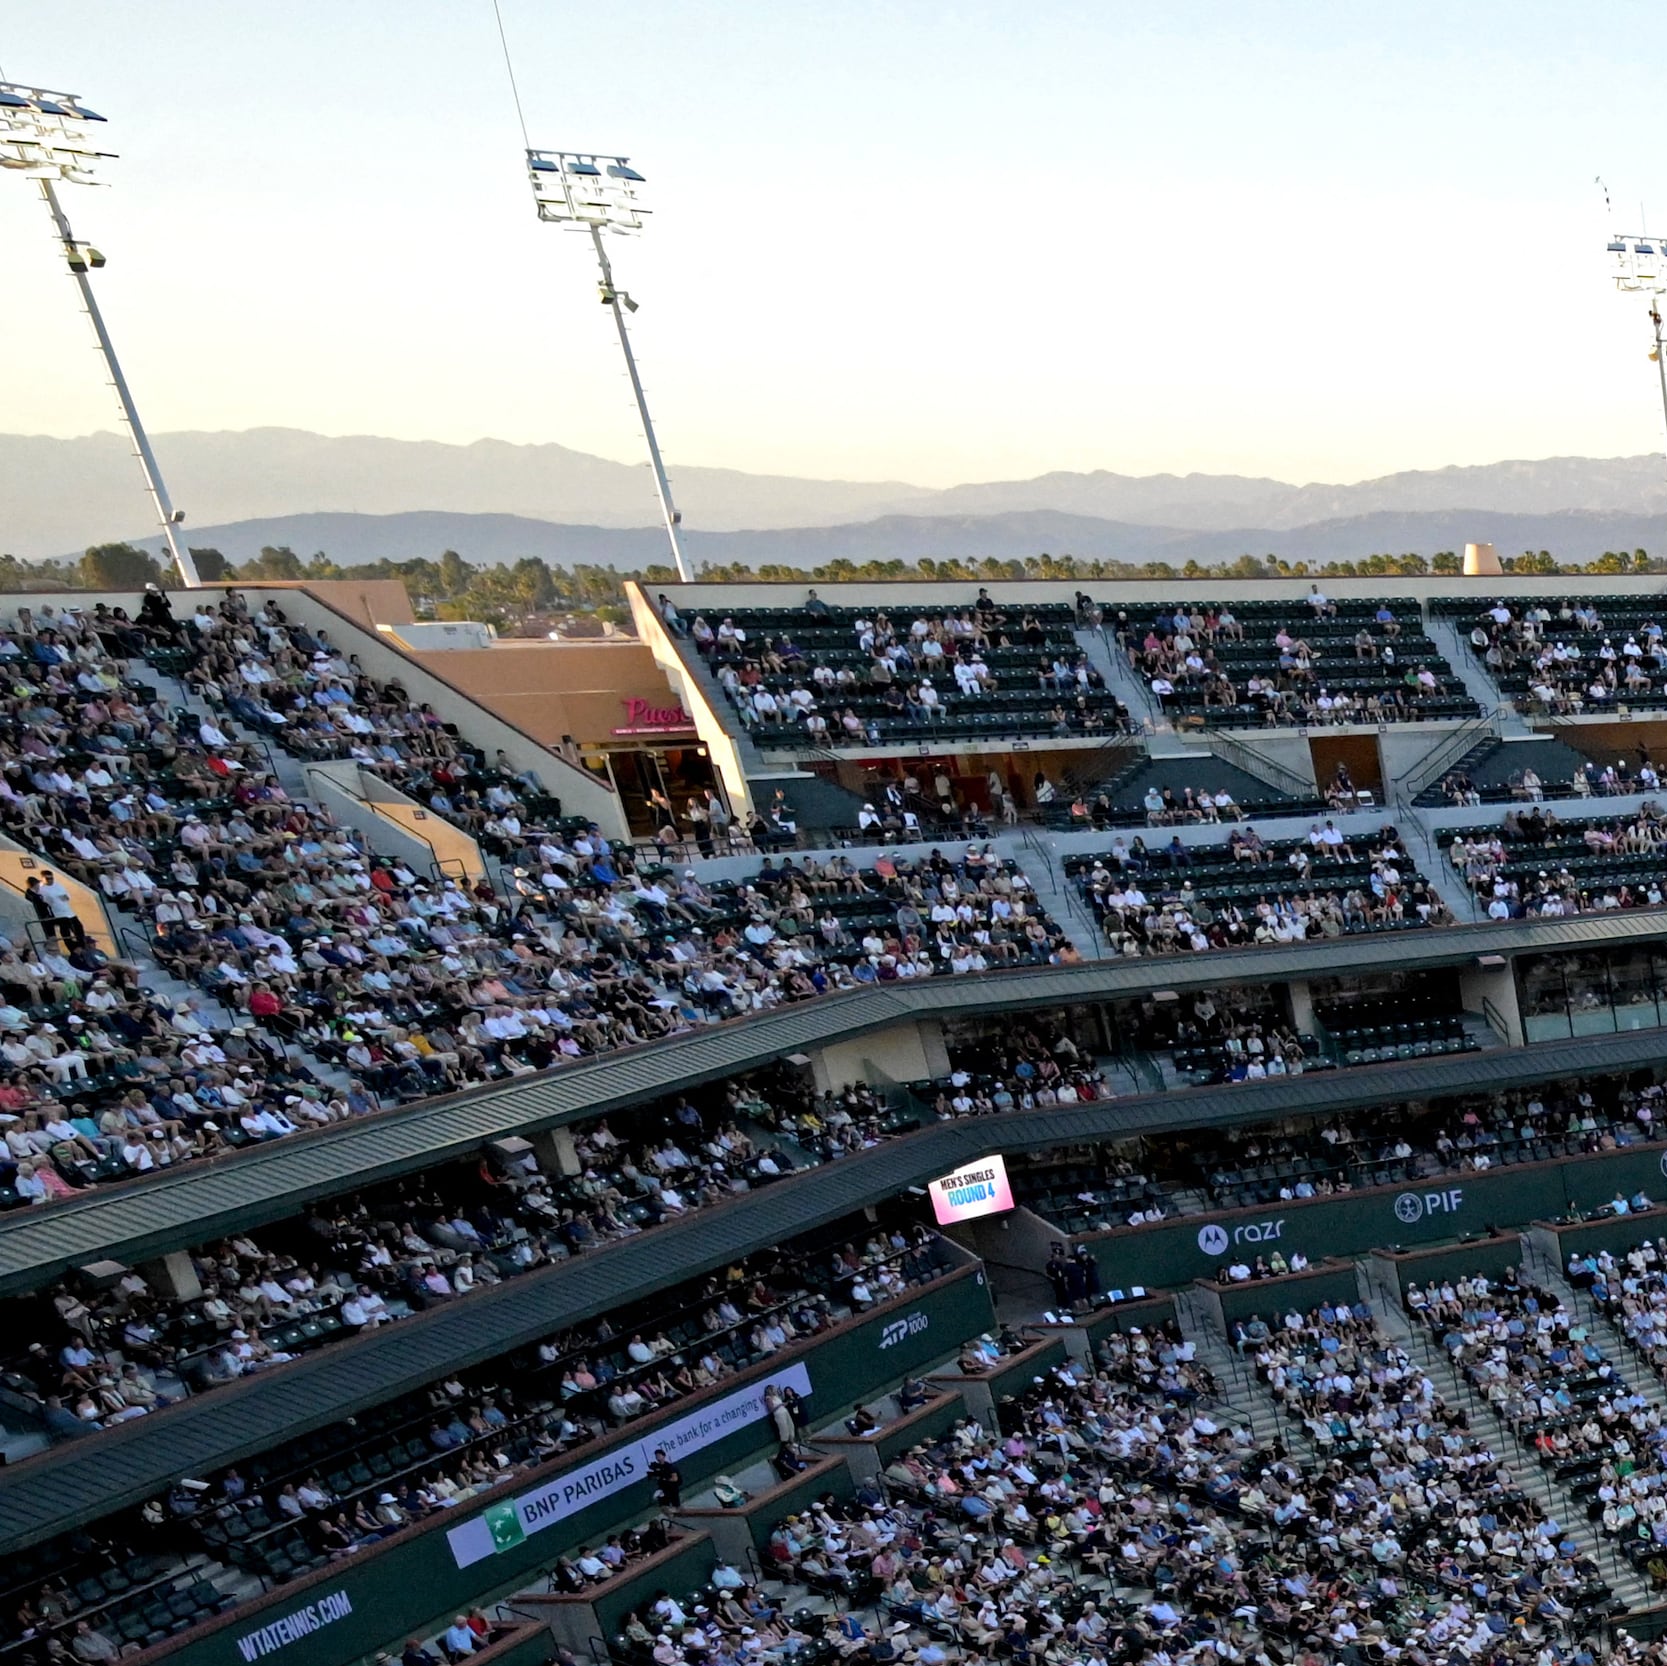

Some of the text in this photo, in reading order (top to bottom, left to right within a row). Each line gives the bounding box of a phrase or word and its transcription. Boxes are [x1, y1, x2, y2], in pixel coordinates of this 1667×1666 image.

[940, 1168, 995, 1191] MEN'S SINGLES
[947, 1182, 996, 1207] ROUND 4
[1424, 1189, 1463, 1215] PIF
[1234, 1219, 1285, 1245] razr
[976, 1272, 984, 1286] 6
[878, 1315, 928, 1350] ATP 1000
[658, 1398, 760, 1452] The bank for a changing
[523, 1456, 635, 1524] BNP PARIBAS
[237, 1590, 353, 1663] WTATENNIS.COM
